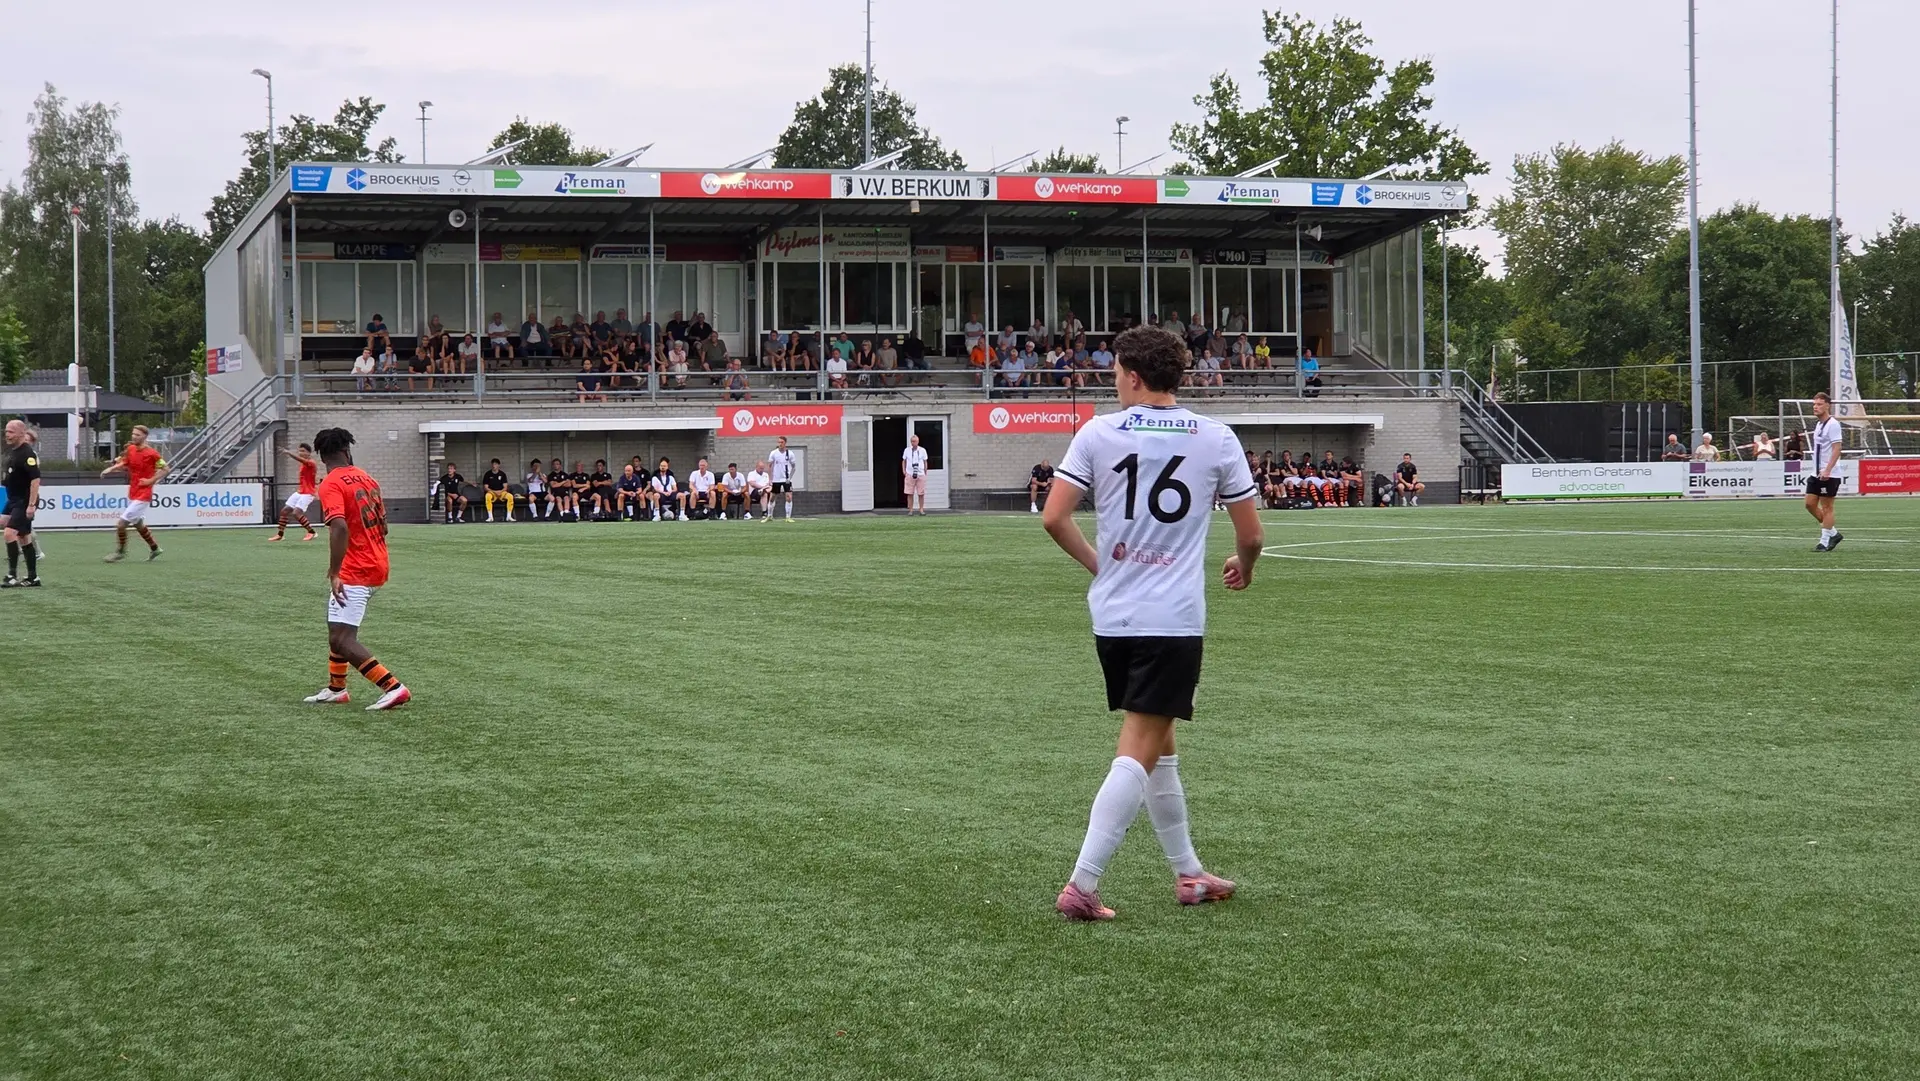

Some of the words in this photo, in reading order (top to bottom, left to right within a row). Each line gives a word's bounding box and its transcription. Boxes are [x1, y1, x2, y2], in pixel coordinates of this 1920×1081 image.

[370, 174, 440, 185] BROEKHUIS
[558, 173, 625, 190] Breman
[859, 178, 887, 196] V.V.
[892, 179, 970, 197] BERKUM
[1056, 183, 1122, 196] wehkamp
[1220, 183, 1279, 199] Breman
[1374, 191, 1431, 201] BROEKHUIS
[337, 244, 388, 256] KLAPPE
[764, 230, 836, 257] Pijlman
[1226, 251, 1246, 262] Mol
[757, 413, 829, 427] wehkamp
[1012, 411, 1081, 425] wehkamp
[1120, 413, 1198, 429] Breman
[1532, 467, 1592, 478] Benthem
[1594, 466, 1653, 477] Gratama
[1559, 481, 1625, 492] advocaten
[1688, 475, 1754, 487] Eikenaar
[1112, 453, 1192, 524] 16
[36, 497, 56, 511] os
[62, 492, 128, 510] Bedden
[149, 494, 181, 508] Bos
[187, 491, 253, 508] Bedden
[72, 512, 99, 520] Droom
[101, 511, 121, 520] bedd
[196, 510, 223, 518] Droom
